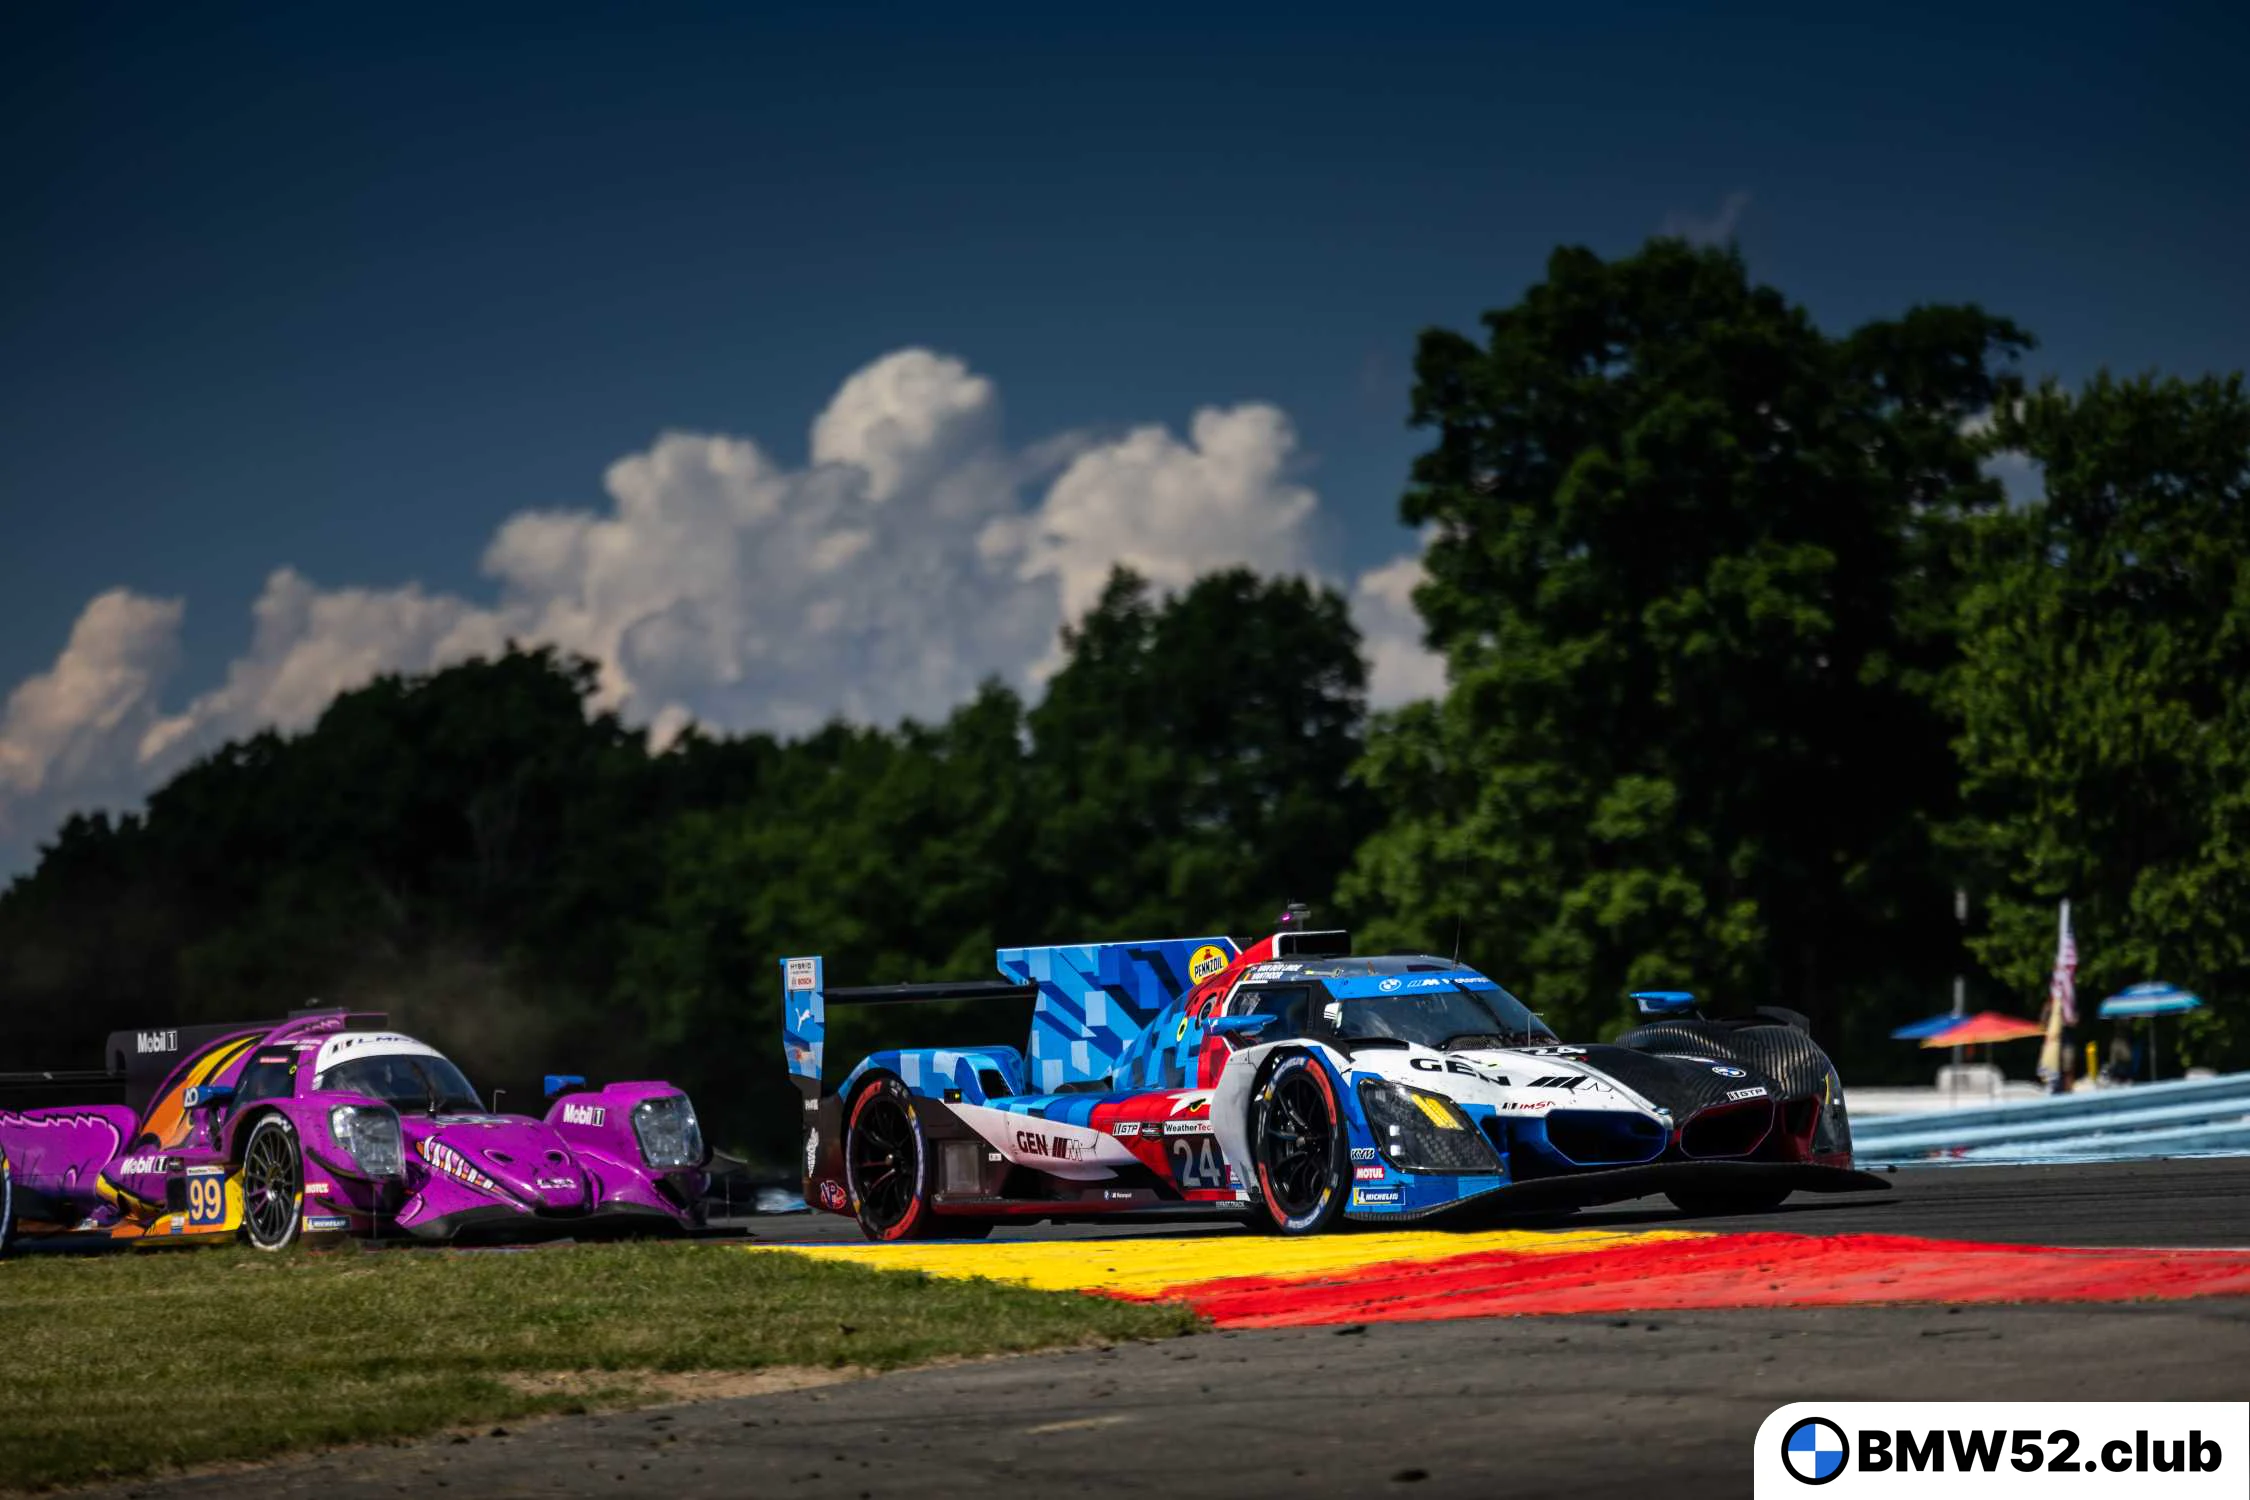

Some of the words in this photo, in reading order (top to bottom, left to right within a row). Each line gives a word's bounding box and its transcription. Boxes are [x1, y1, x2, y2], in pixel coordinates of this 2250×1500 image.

[1194, 956, 1223, 979] PENNZOIL
[797, 977, 812, 985] BOSCH
[137, 1032, 166, 1053] Mobil
[1410, 1057, 1511, 1087] GEN
[1740, 1088, 1763, 1097] GTP
[563, 1104, 593, 1125] Mobil
[1121, 1123, 1138, 1133] GTP
[1165, 1123, 1212, 1133] WeatherTec
[1016, 1130, 1048, 1157] GEN
[121, 1156, 155, 1175] Mobil
[1173, 1138, 1220, 1187] 24
[1356, 1168, 1384, 1179] MOTUL
[190, 1179, 221, 1220] 99
[1365, 1193, 1399, 1201] MICHELIN
